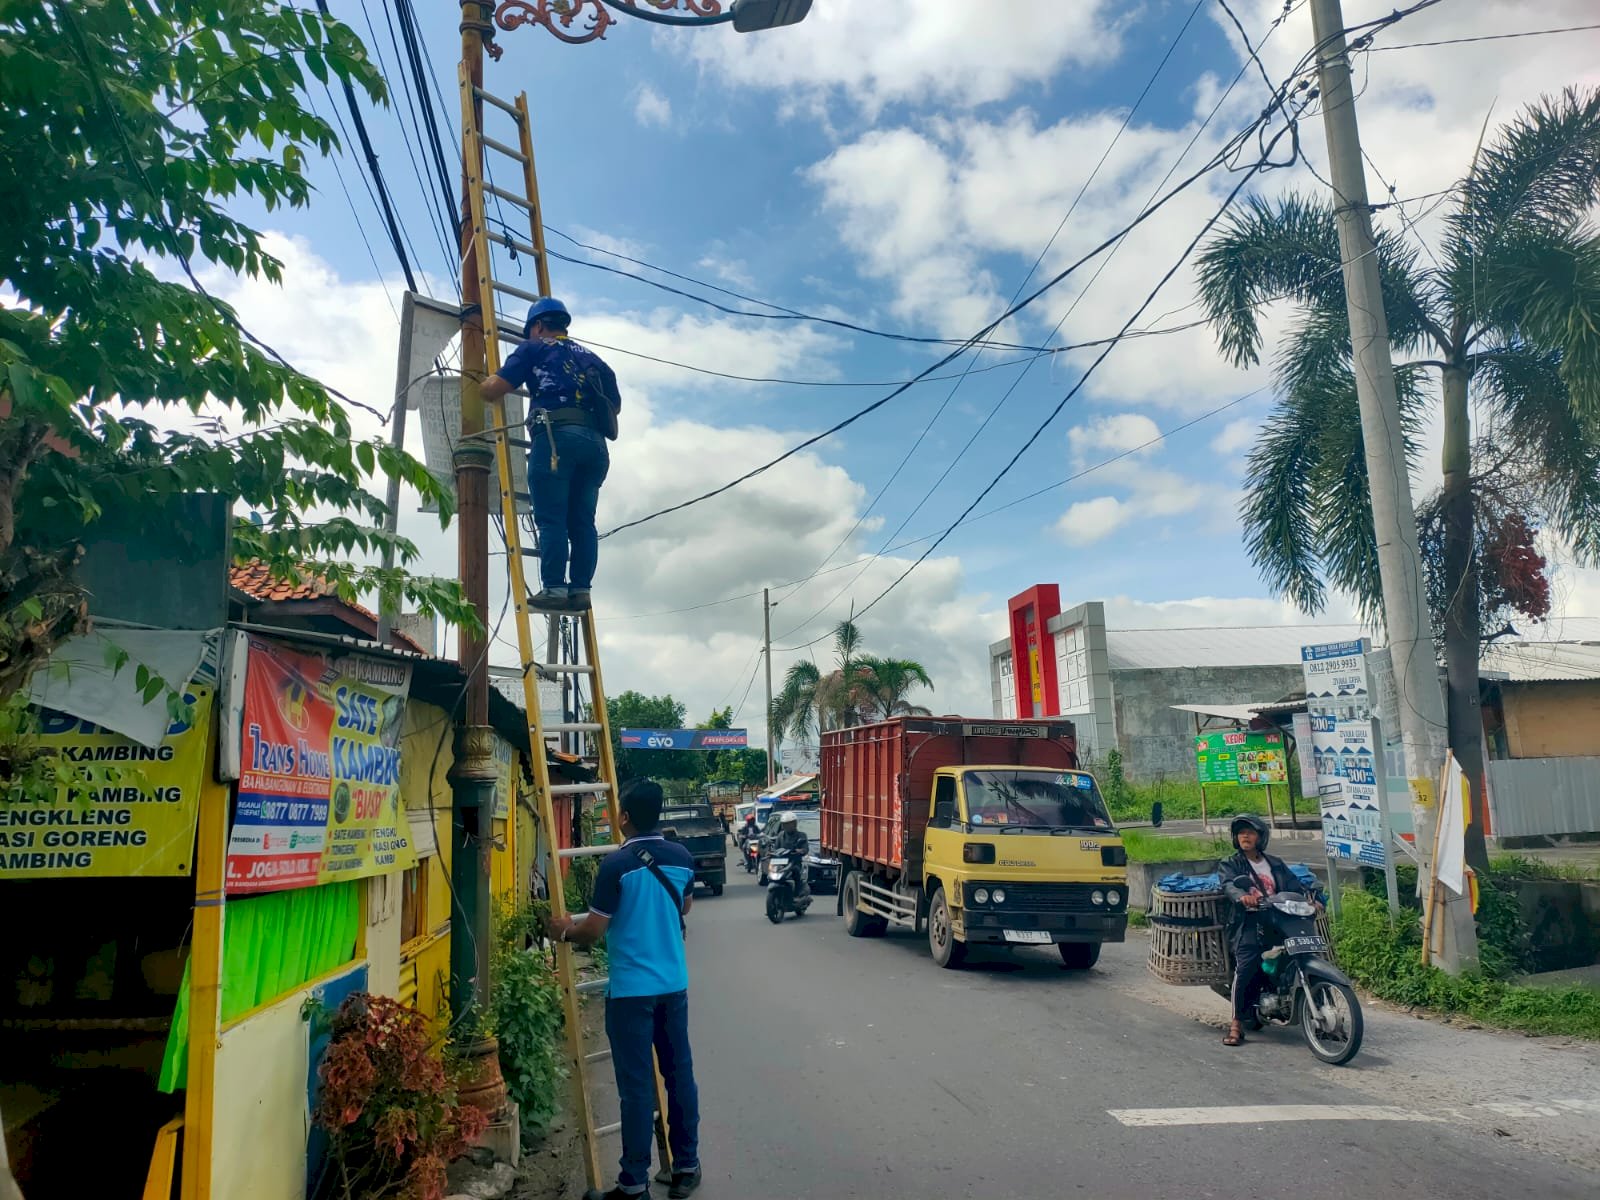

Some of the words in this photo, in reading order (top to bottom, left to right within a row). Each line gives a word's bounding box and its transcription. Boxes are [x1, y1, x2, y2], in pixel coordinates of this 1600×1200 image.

[335, 684, 378, 736] SATE
[648, 736, 674, 748] evo
[61, 746, 174, 762] KAMBING
[67, 787, 181, 803] KAMBING
[43, 830, 148, 847] GORENG
